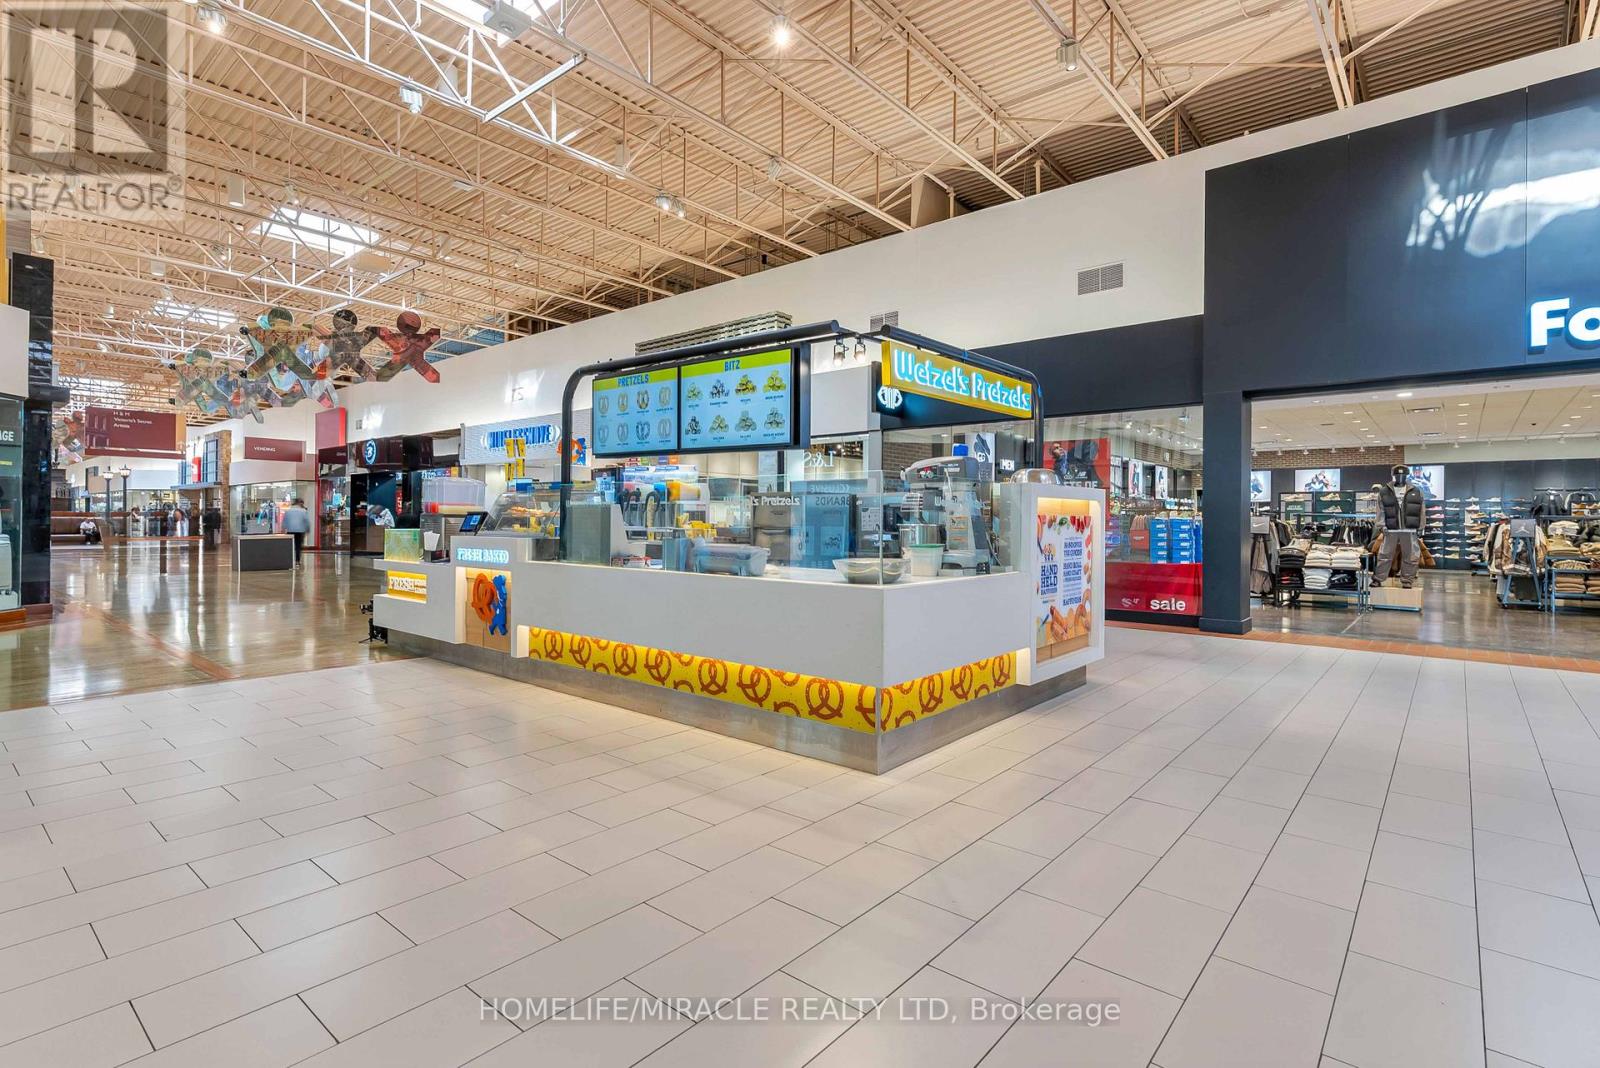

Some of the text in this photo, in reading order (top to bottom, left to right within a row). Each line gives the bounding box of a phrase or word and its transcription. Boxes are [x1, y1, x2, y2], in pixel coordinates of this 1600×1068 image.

[724, 359, 741, 372] BITZ
[617, 374, 650, 387] PRETZELS
[894, 348, 1031, 411] Wetzel's Pretzels
[1041, 564, 1058, 576] HAND
[1041, 576, 1058, 588] HELD
[1150, 597, 1186, 611] sale
